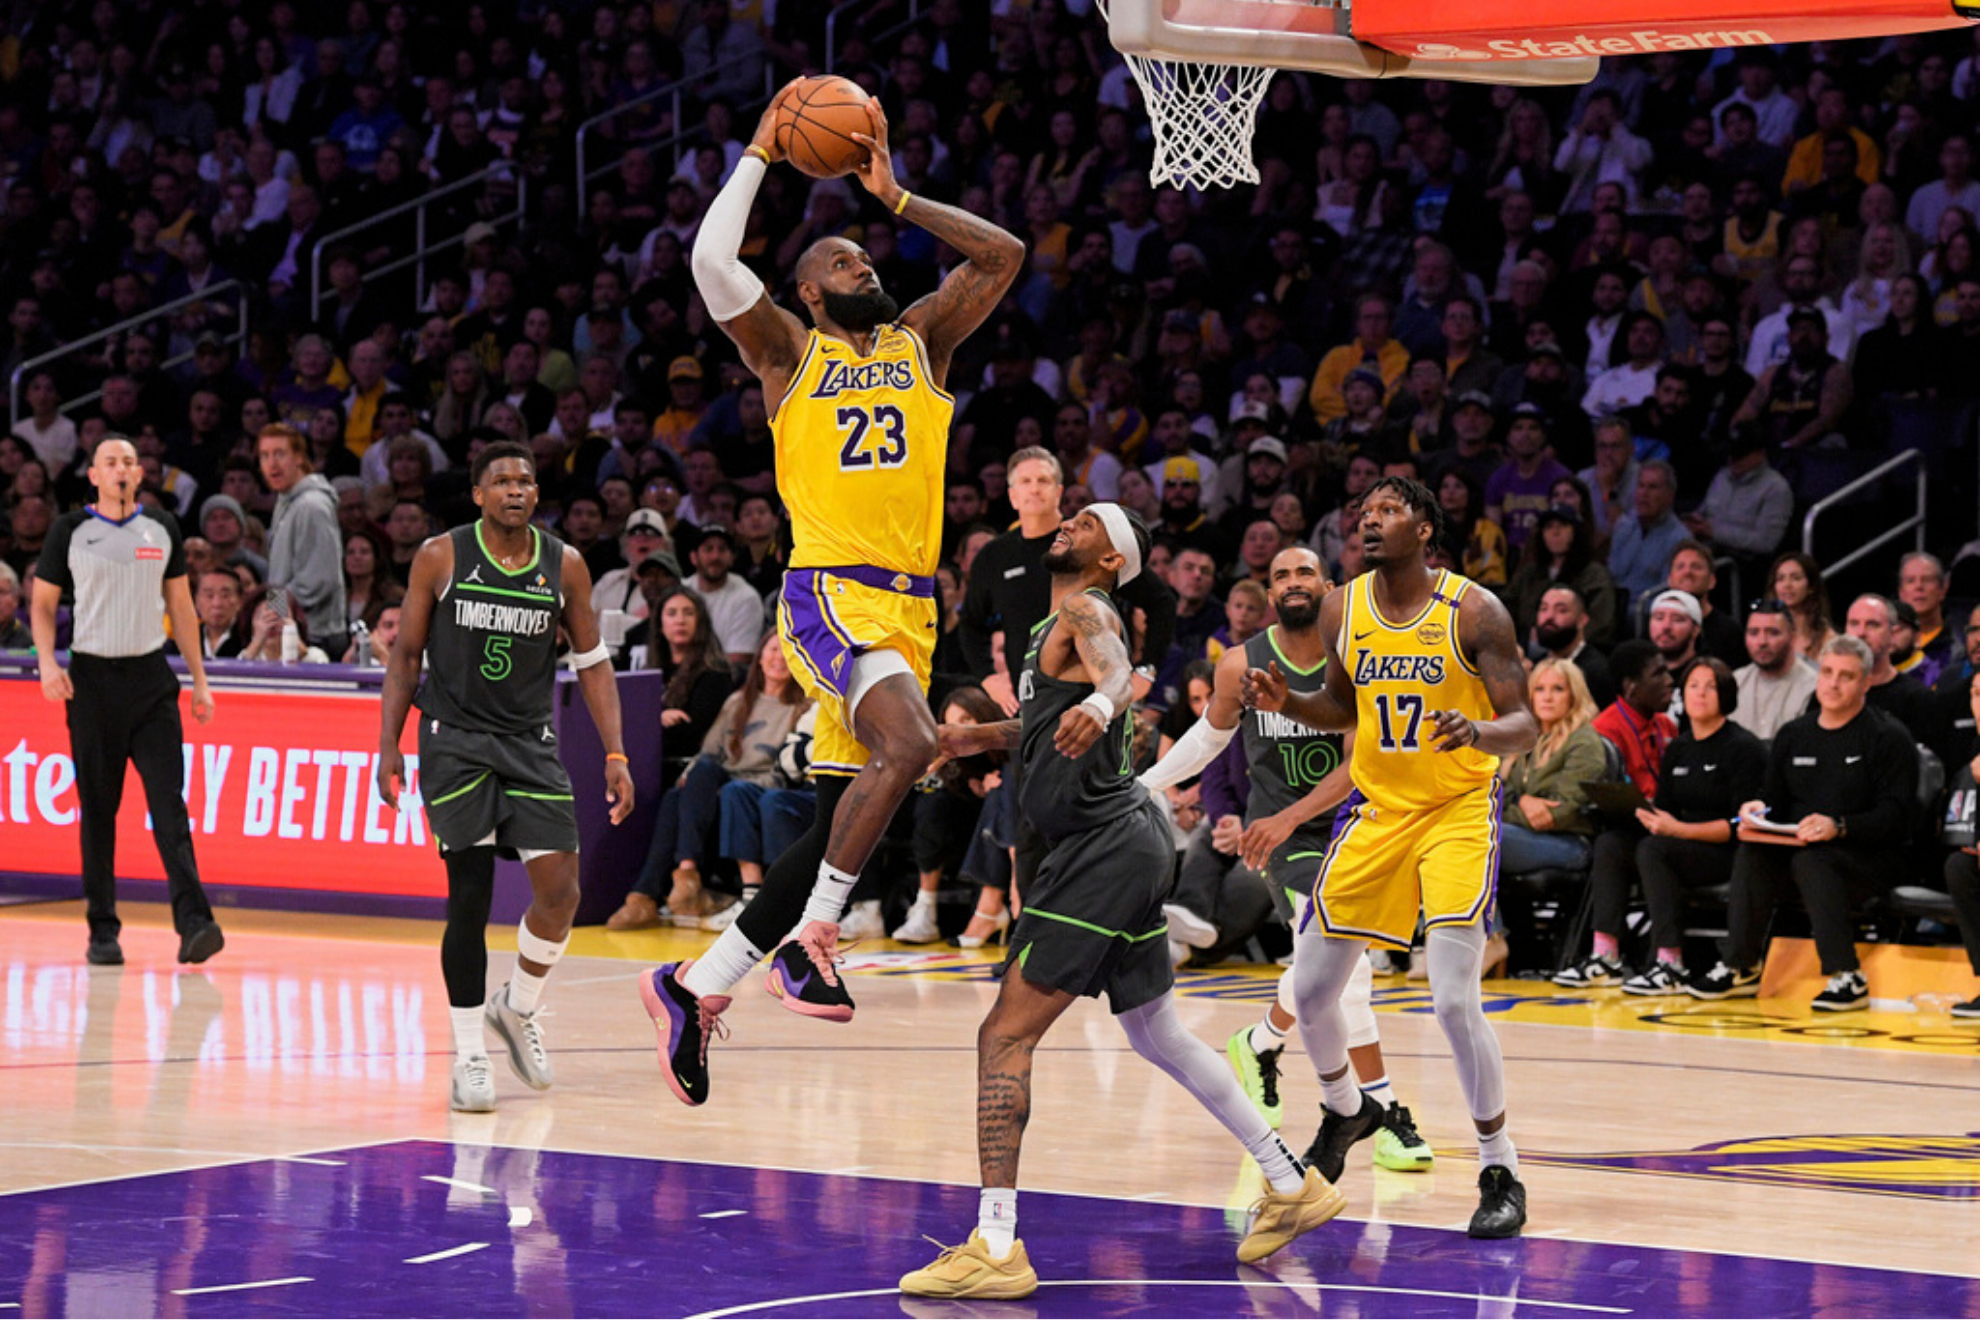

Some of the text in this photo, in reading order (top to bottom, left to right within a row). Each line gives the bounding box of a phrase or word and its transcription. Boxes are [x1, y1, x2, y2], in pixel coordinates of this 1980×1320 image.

[809, 359, 915, 399] LAKERS
[837, 404, 908, 472] 23
[454, 599, 551, 637] TIMBERWOLVES
[480, 635, 512, 681] 5
[1354, 648, 1446, 686] LAKERS
[1375, 693, 1424, 752] 17
[0, 738, 81, 826] te
[1278, 741, 1339, 787] 10
[243, 747, 426, 846] BETTER
